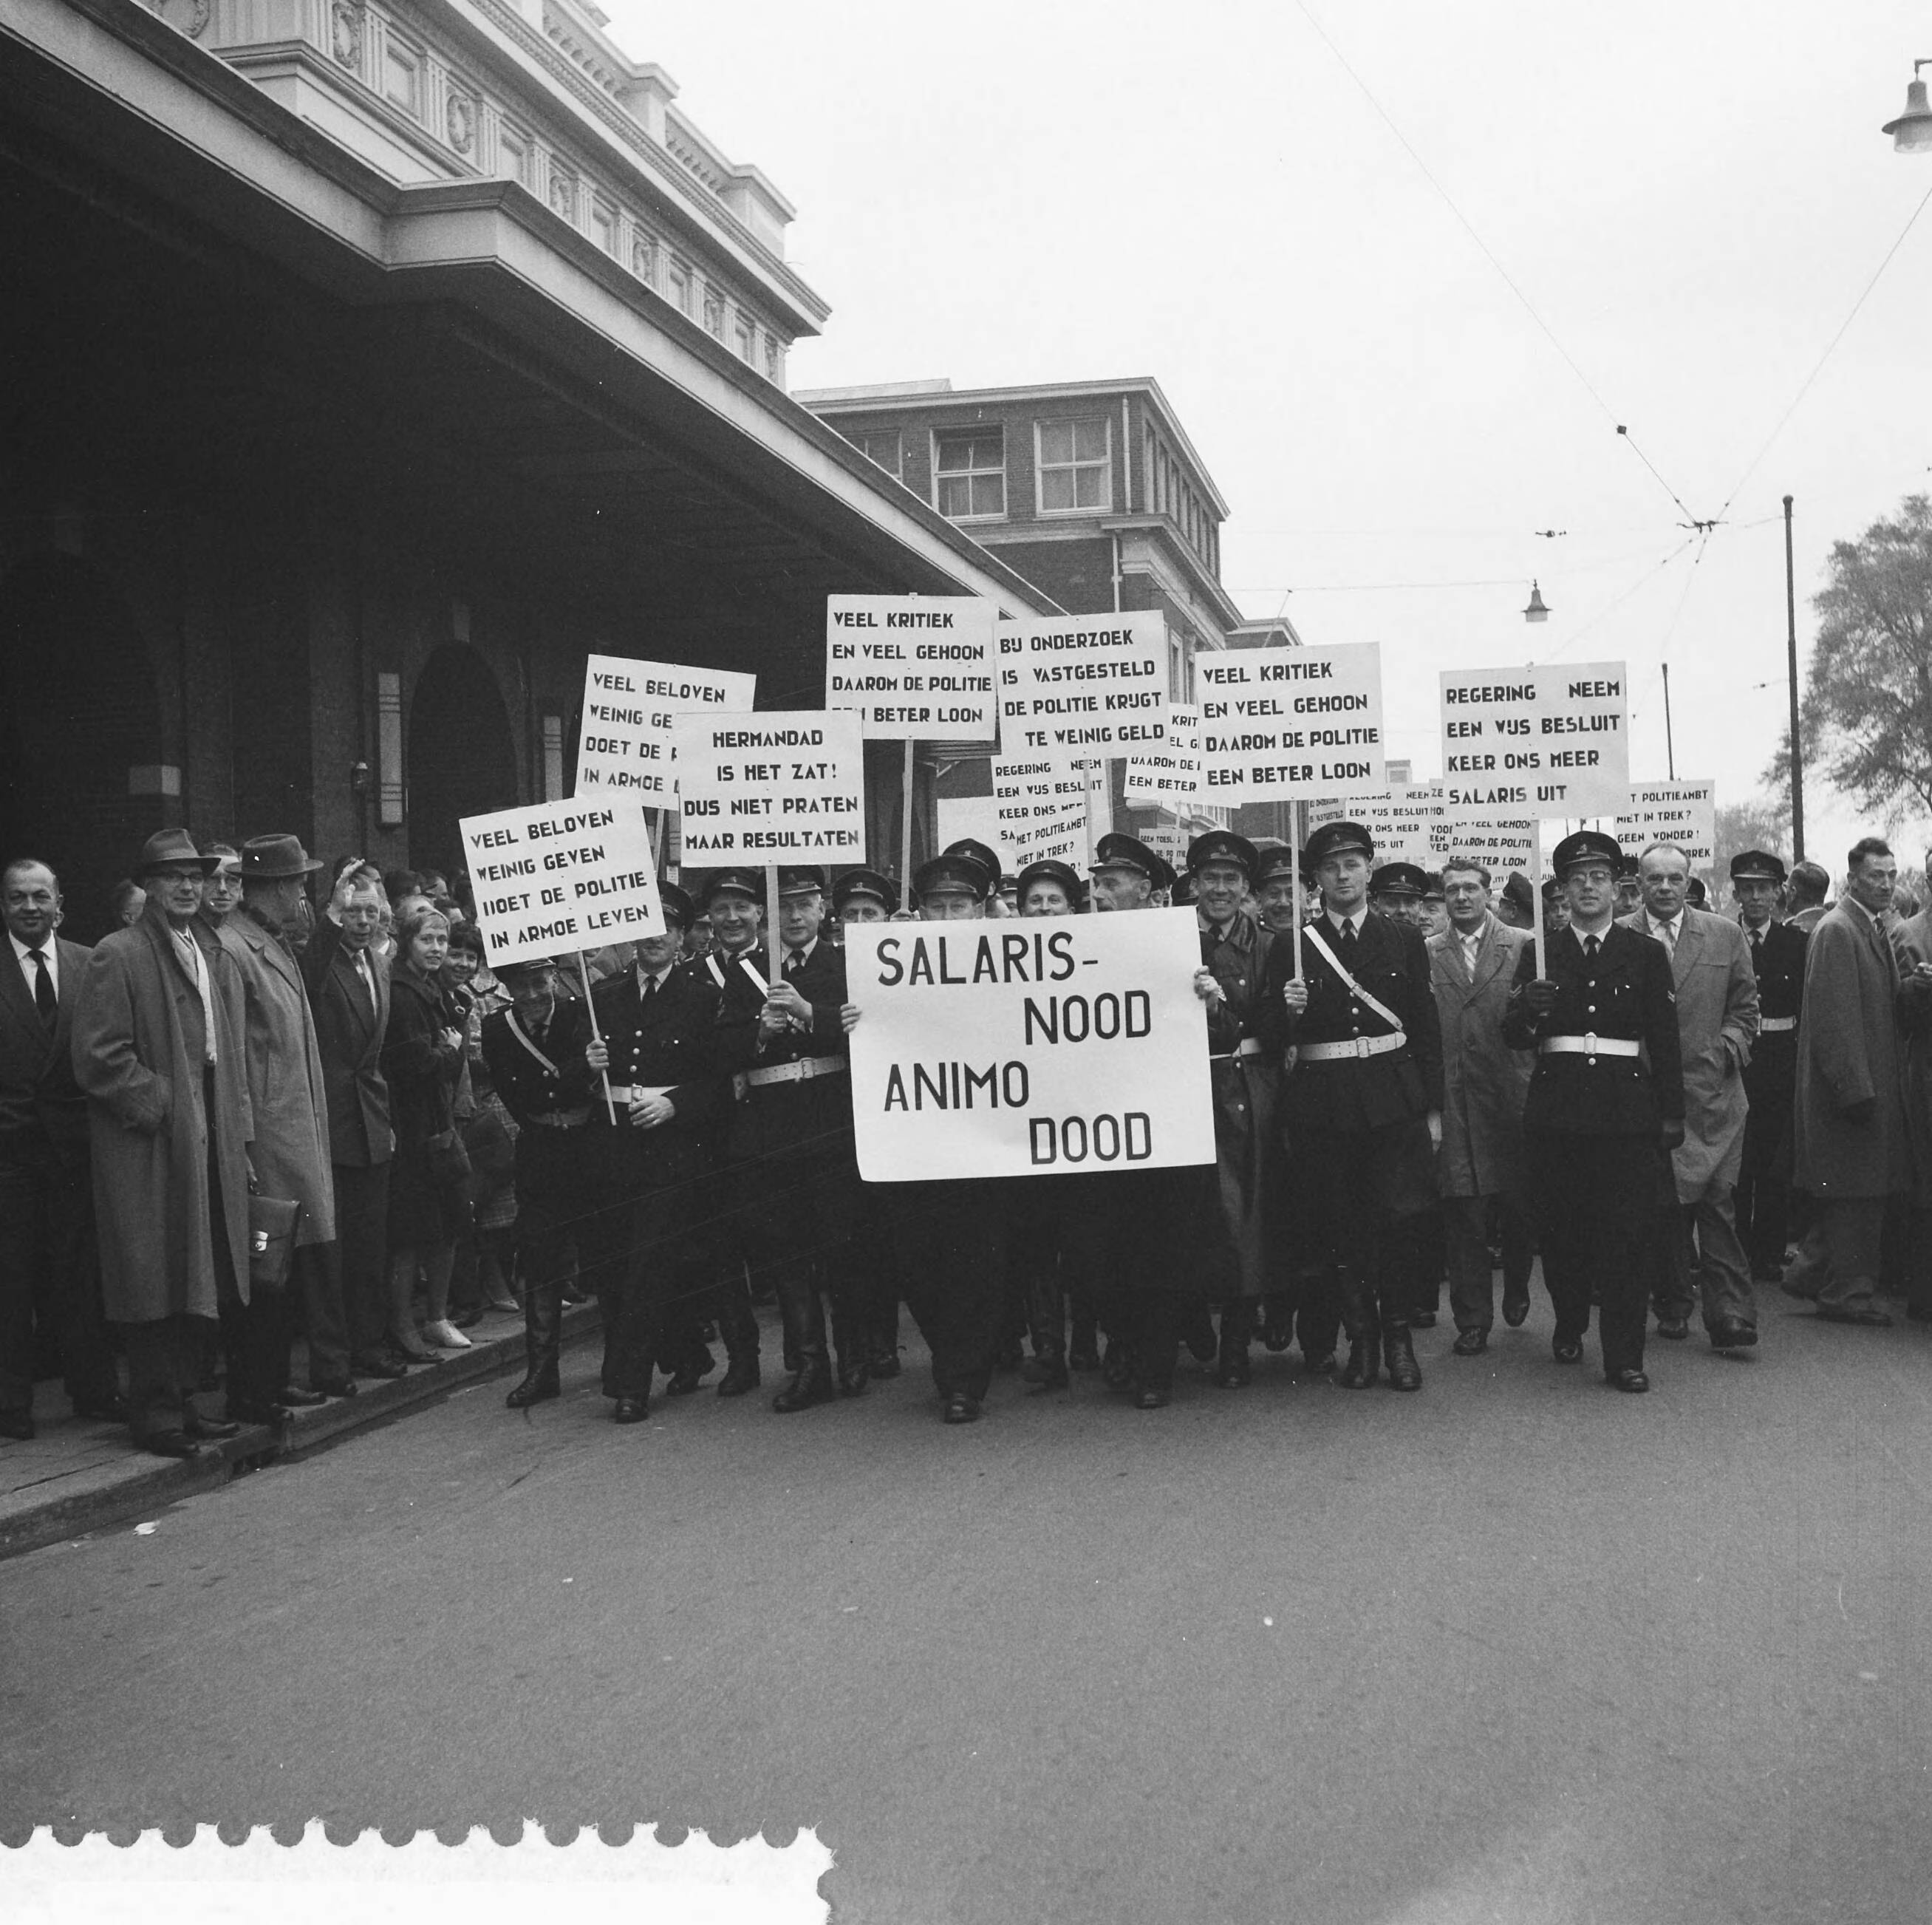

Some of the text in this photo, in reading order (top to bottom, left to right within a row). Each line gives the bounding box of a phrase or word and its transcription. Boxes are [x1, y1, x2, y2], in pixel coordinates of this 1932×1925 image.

[834, 613, 953, 627] VEEL KRITIEK
[1031, 630, 1133, 650] ONDERZOEK
[833, 644, 983, 660] EN VEEL GEHOON
[1003, 661, 1155, 685] IS VASTGESTELD
[1204, 662, 1332, 684] VEEL KRITIEK
[594, 673, 725, 703] VEEL BELOVEN
[833, 676, 991, 691] DAAROM DE POLITIE
[1447, 681, 1619, 703] REGERING NEEM
[590, 704, 642, 725] WEINIG
[874, 708, 929, 722] BETER
[938, 708, 982, 722] LOON
[1005, 701, 1026, 716] DE
[1034, 697, 1098, 715] POLITIE
[1204, 695, 1367, 718] EN VEEL GEHOON
[1172, 715, 1198, 726] KRIT
[1447, 721, 1481, 737] EEN
[1542, 715, 1619, 734] BESLUIT
[713, 730, 822, 747] HERMANDAD
[1025, 724, 1164, 746] TE WEINIG GELD
[1206, 735, 1275, 752] DAAROM
[1283, 732, 1304, 748] DE
[1310, 728, 1379, 746] POLITIE
[586, 737, 631, 754] DOET
[640, 743, 660, 759] DE
[996, 763, 1051, 777] REGERING
[1131, 757, 1175, 768] DAAROM
[1181, 760, 1193, 770] DE
[1449, 750, 1599, 771] KEER ONS MEER
[584, 768, 599, 783] IN
[608, 772, 663, 791] ARMOE
[717, 763, 836, 781] IS HET ZAT!
[1207, 762, 1370, 786] EEN BETER LOON
[997, 787, 1019, 797] EEN
[1129, 776, 1196, 791] EEN BETER
[1450, 786, 1566, 804] SALARIS UIT
[1642, 790, 1707, 802] POLITIEAMBT
[684, 797, 857, 816] DUS NIET PRATEN
[1000, 808, 1028, 819] KEER
[1034, 805, 1056, 816] ONS
[1393, 808, 1428, 816] BESLUIT
[1645, 813, 1653, 822] IN
[471, 810, 613, 848] VEEL BELOVEN
[1017, 817, 1086, 845] HET POLITIEAMBT
[1397, 824, 1419, 832] MEER
[686, 831, 858, 849] MAAR RESULTATEN
[1453, 837, 1485, 846] DAAROM
[1488, 838, 1498, 847] DE
[1618, 833, 1644, 843] GEEN
[477, 845, 604, 881] WEINIG GEVEN
[1017, 853, 1033, 866] NIET
[1037, 850, 1044, 860] IN
[1503, 857, 1526, 866] LOON
[541, 887, 565, 905] DE
[575, 871, 646, 898] POLITIE
[491, 904, 649, 949] IN ARMOE LEVEN
[877, 932, 1098, 986] SALARIS-
[1025, 990, 1150, 1045] NOOD
[884, 1061, 1028, 1111] ANIMO
[1029, 1112, 1151, 1165] DOOD
